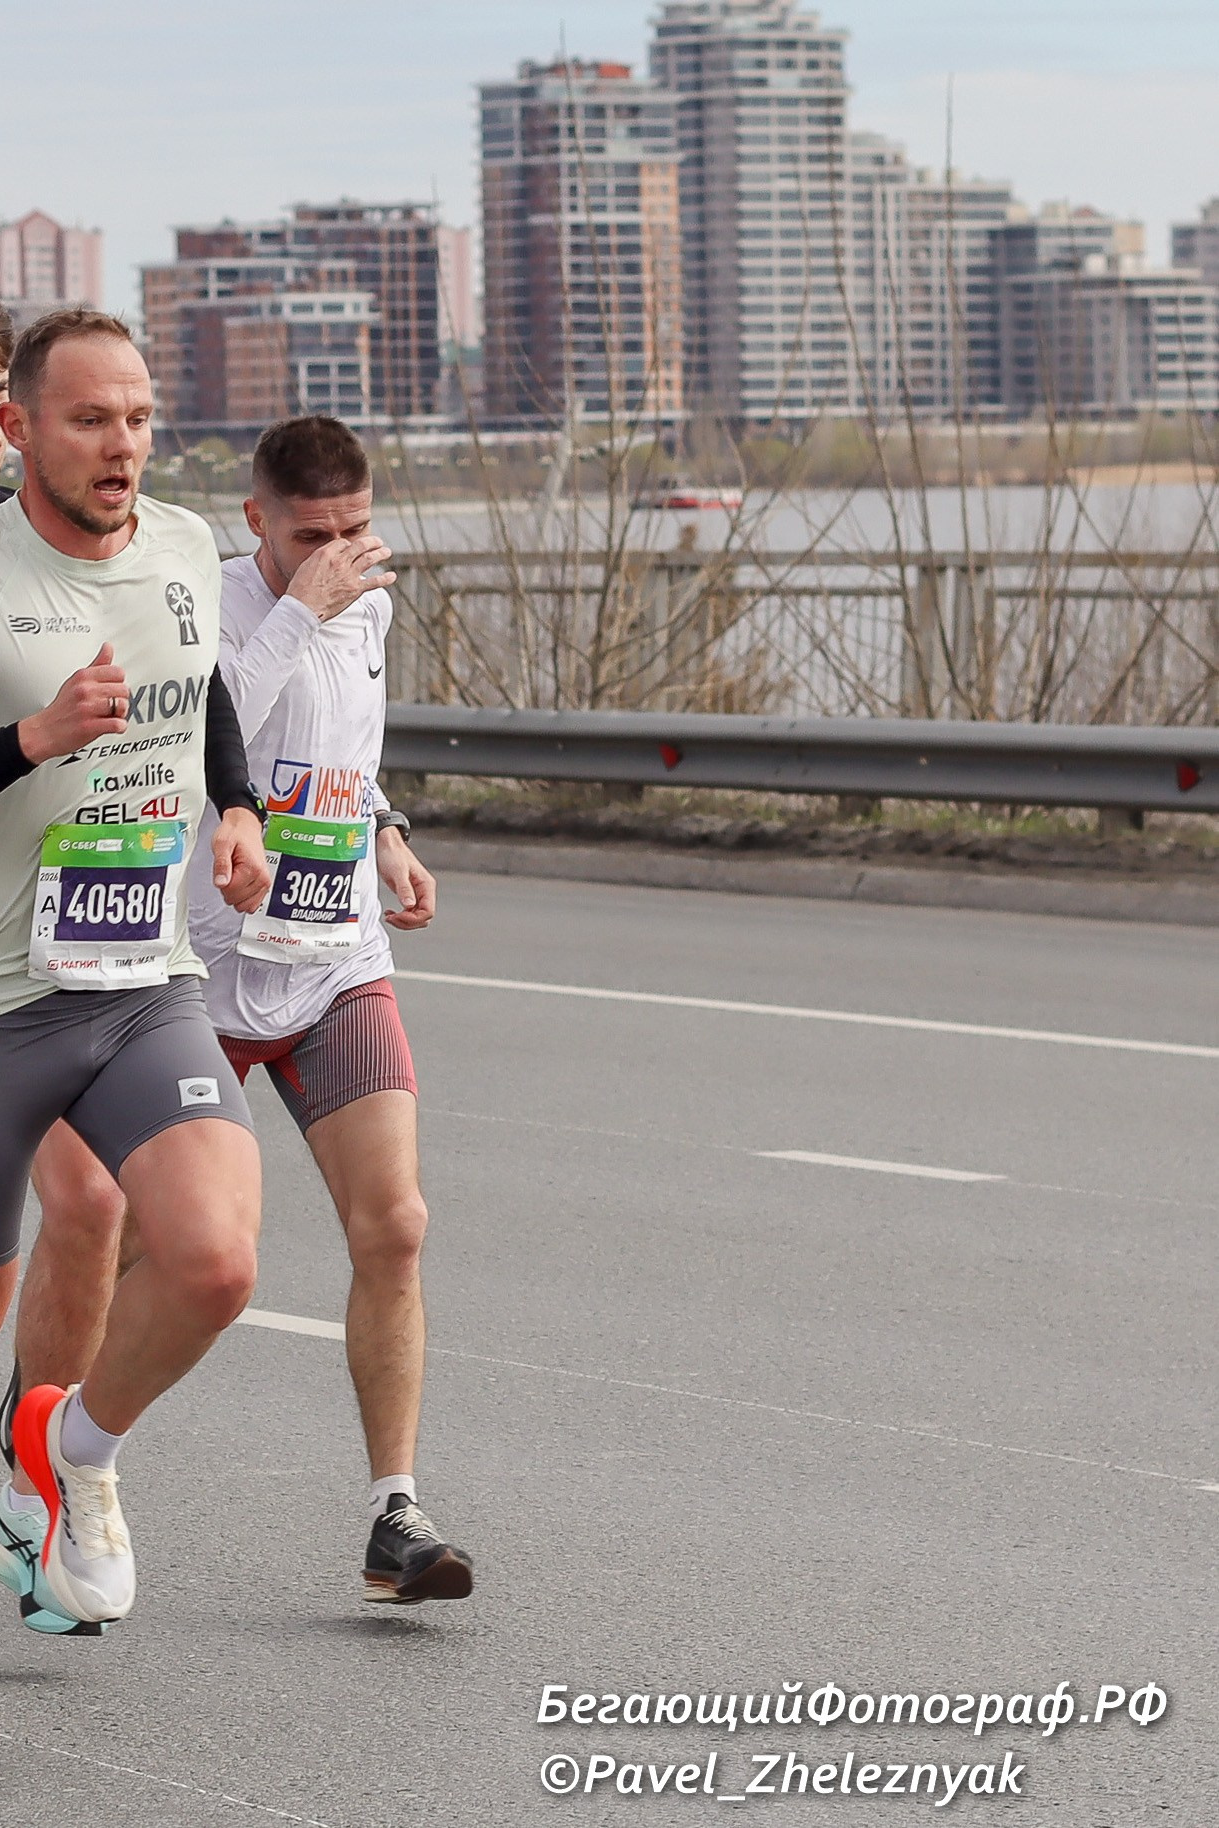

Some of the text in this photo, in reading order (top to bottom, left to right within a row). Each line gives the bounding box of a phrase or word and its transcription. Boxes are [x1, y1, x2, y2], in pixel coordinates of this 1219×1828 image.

[125, 675, 205, 725] XION
[93, 762, 175, 794] r.a.w.life
[66, 883, 161, 924] 40580
[281, 871, 351, 910] 30622
[290, 908, 337, 922] ВЛАДИМИР
[269, 935, 302, 946] МАГНИТ
[60, 959, 100, 969] МАГНИТ
